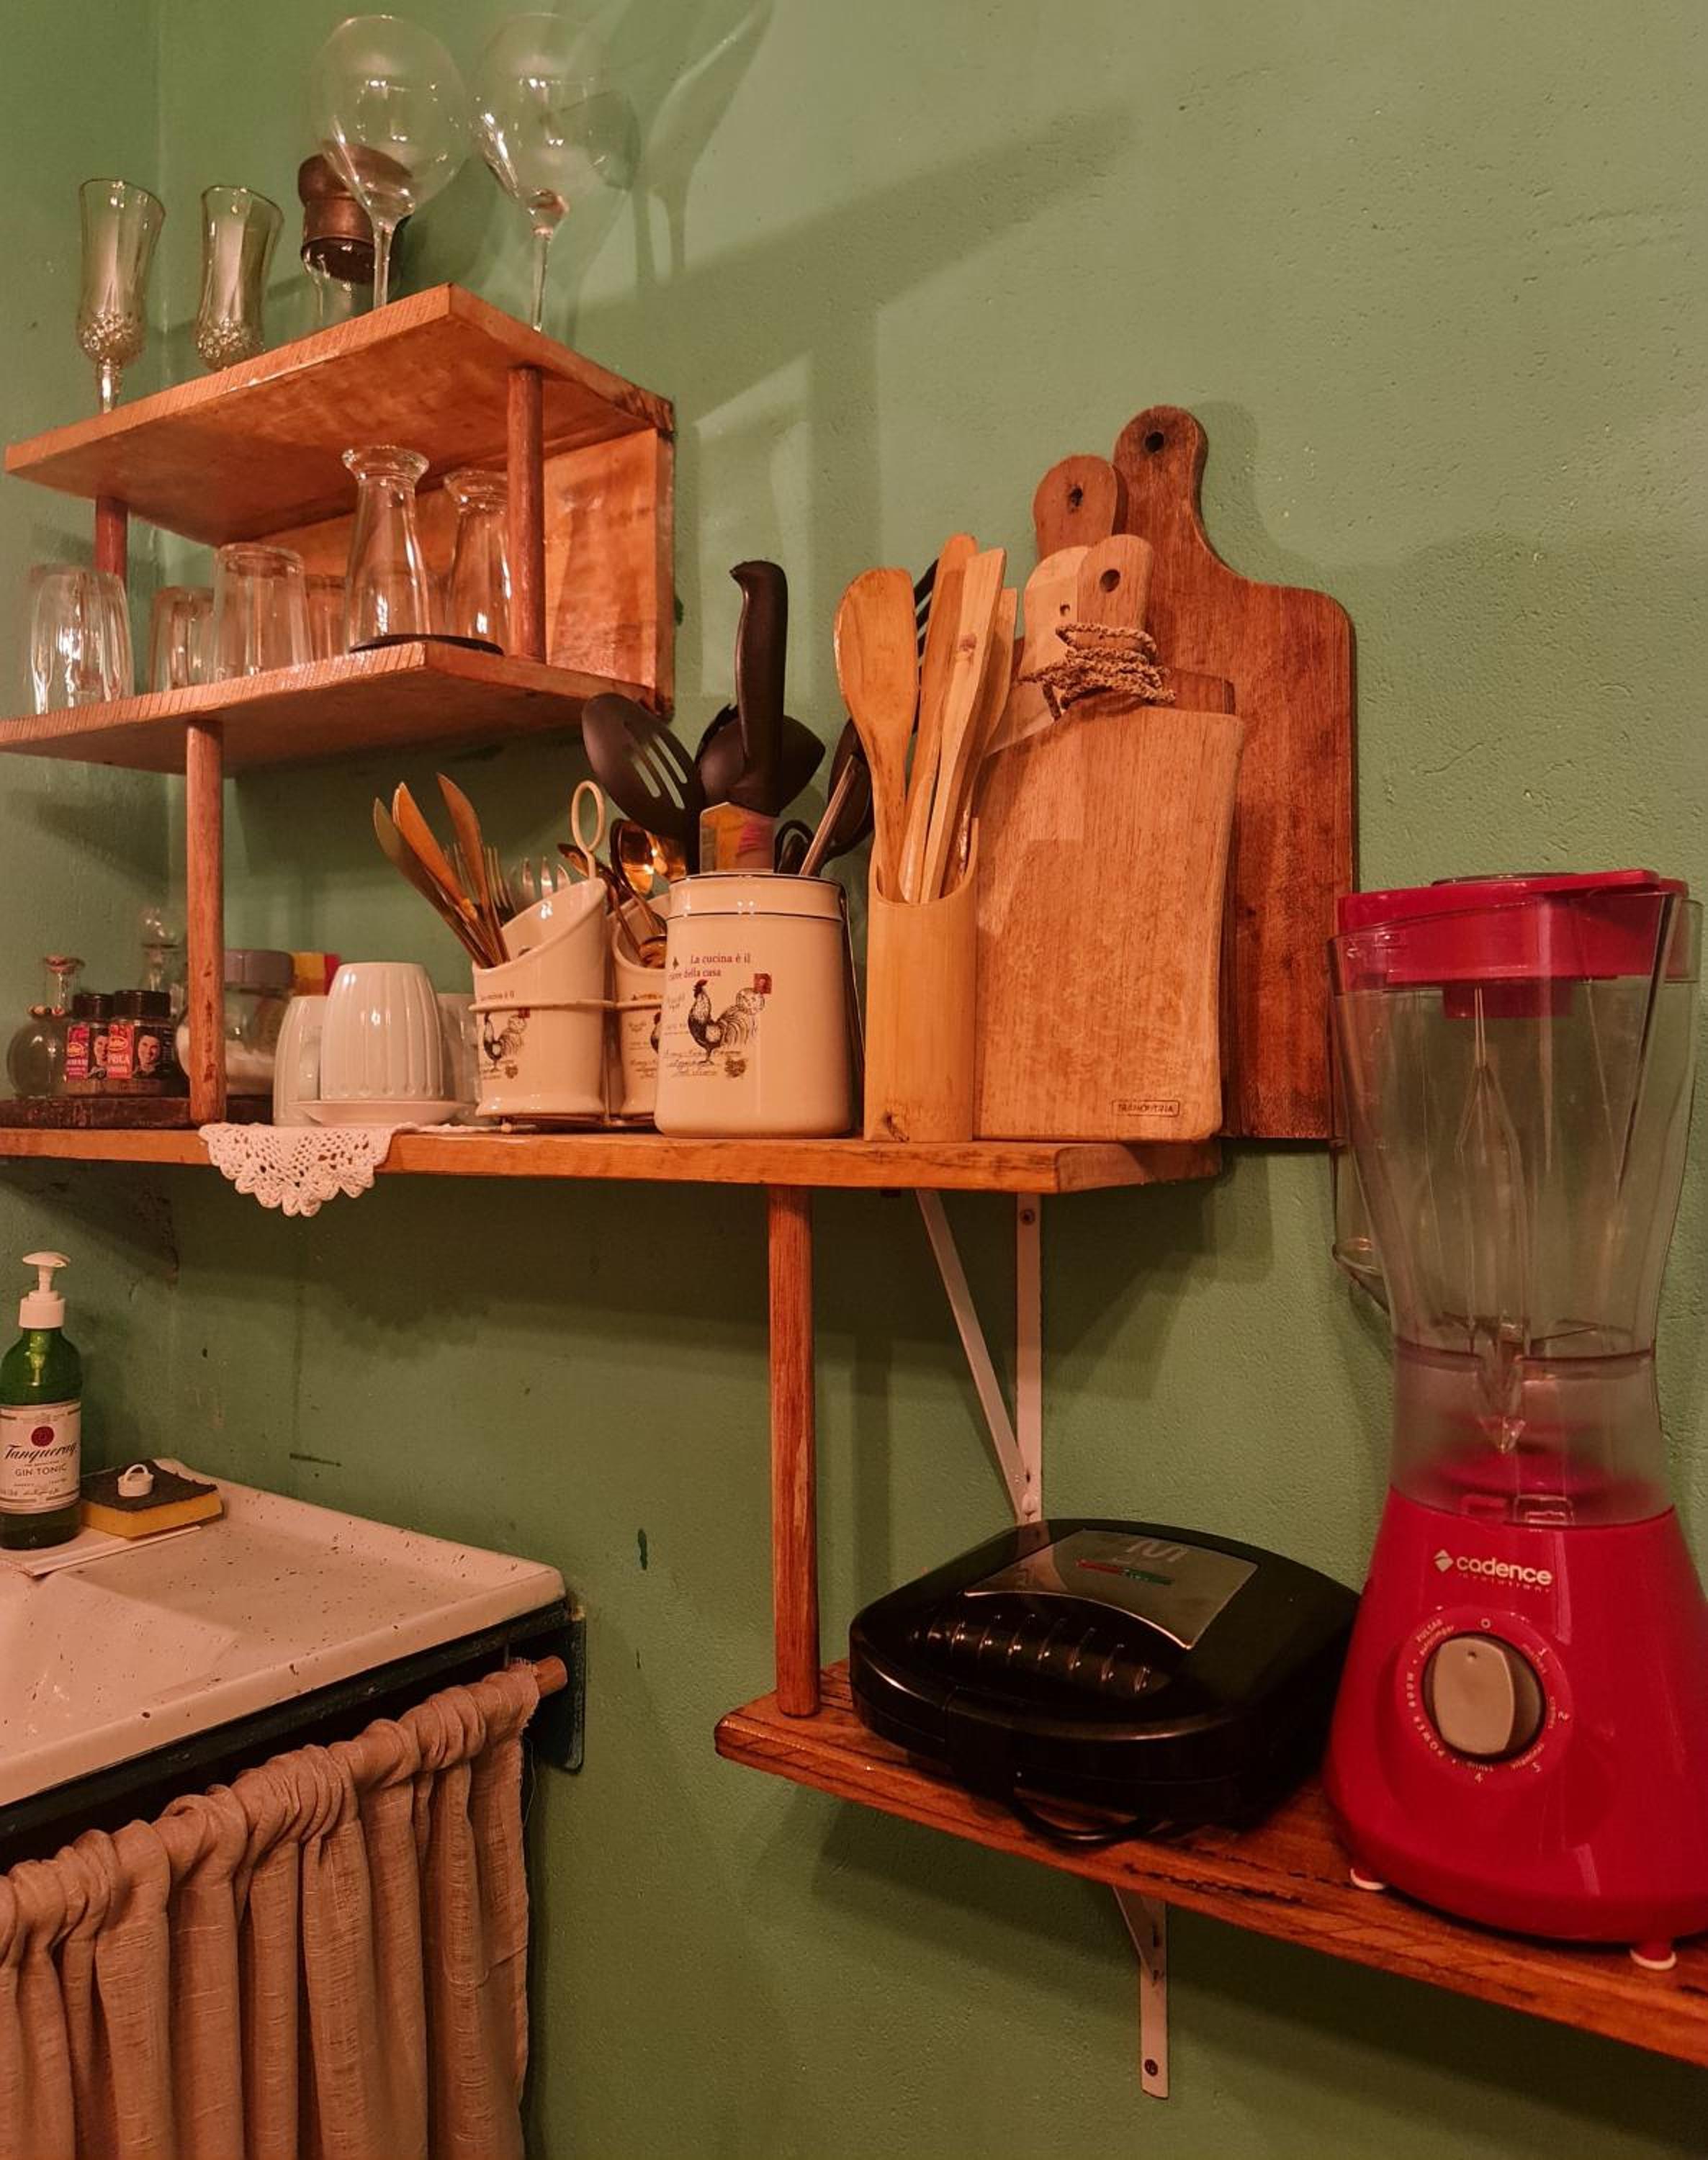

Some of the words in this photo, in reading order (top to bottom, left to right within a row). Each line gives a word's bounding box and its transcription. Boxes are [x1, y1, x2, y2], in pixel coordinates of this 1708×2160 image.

[691, 955, 700, 964] La
[702, 955, 732, 963] cucina
[744, 953, 751, 963] il
[5, 1442, 77, 1464] Tanqueray
[15, 1468, 32, 1477] GIN
[37, 1462, 67, 1475] TONIC
[1456, 1557, 1552, 1585] cadence
[1474, 1772, 1483, 1783] 4
